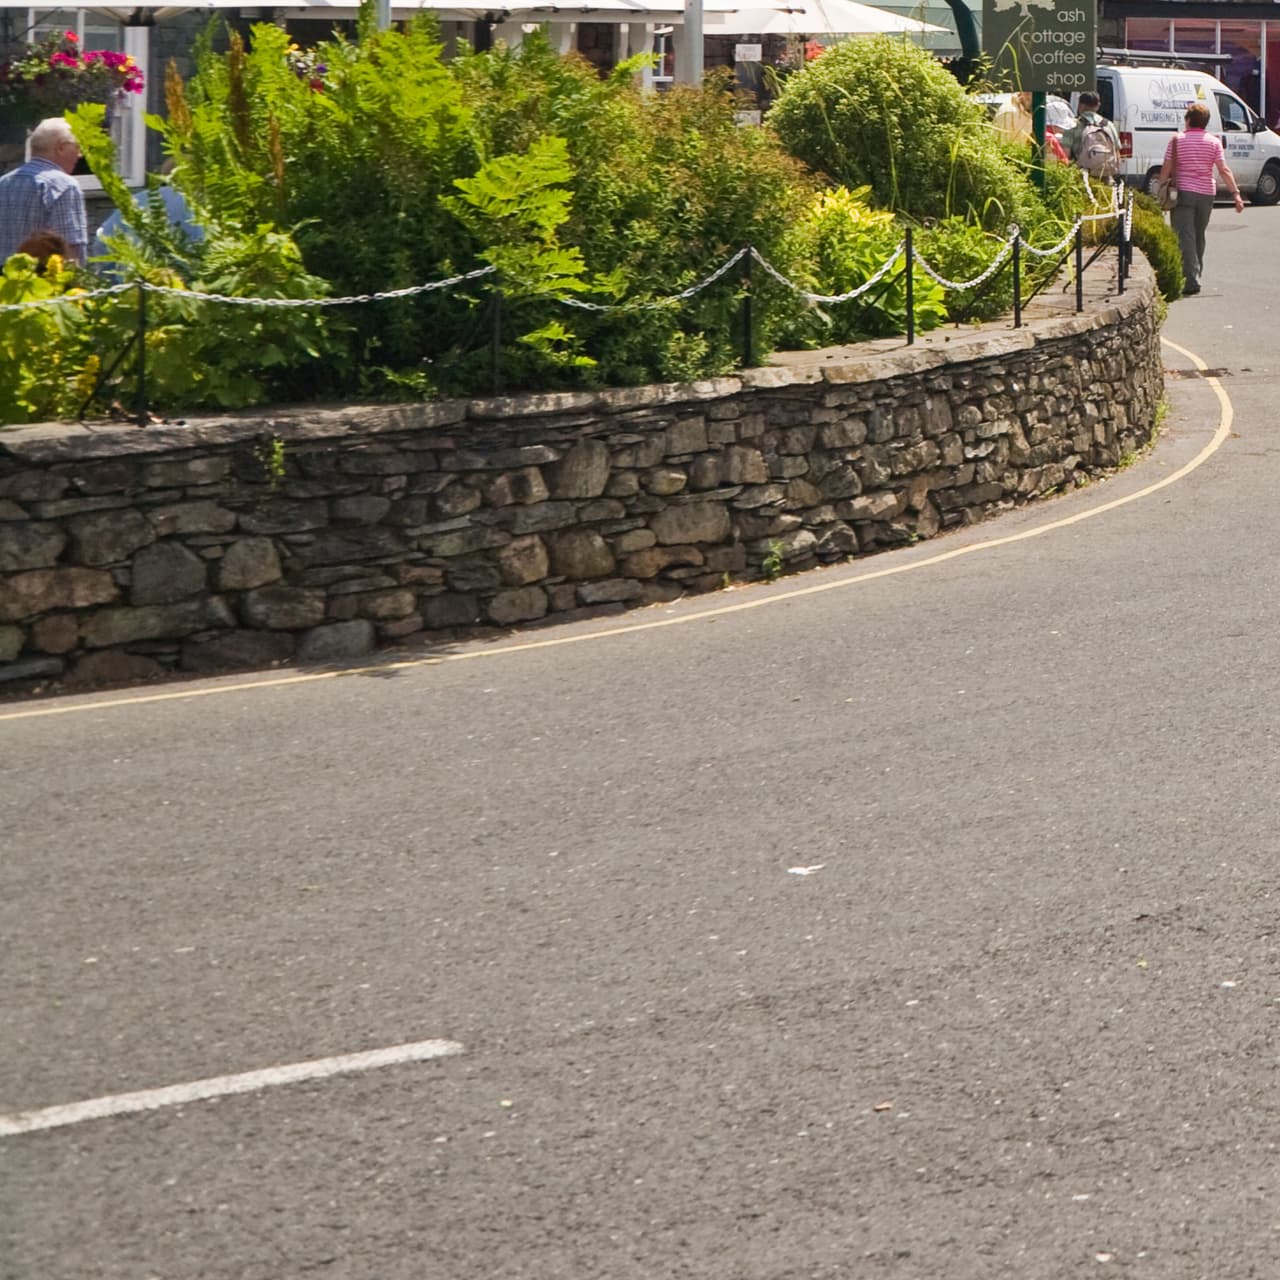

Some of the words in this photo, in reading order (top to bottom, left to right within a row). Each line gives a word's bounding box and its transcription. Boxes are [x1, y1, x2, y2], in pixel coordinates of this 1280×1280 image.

[1057, 8, 1086, 22] ash
[1021, 29, 1086, 46] cottage
[1032, 50, 1086, 64] coffee
[1046, 72, 1086, 87] shop
